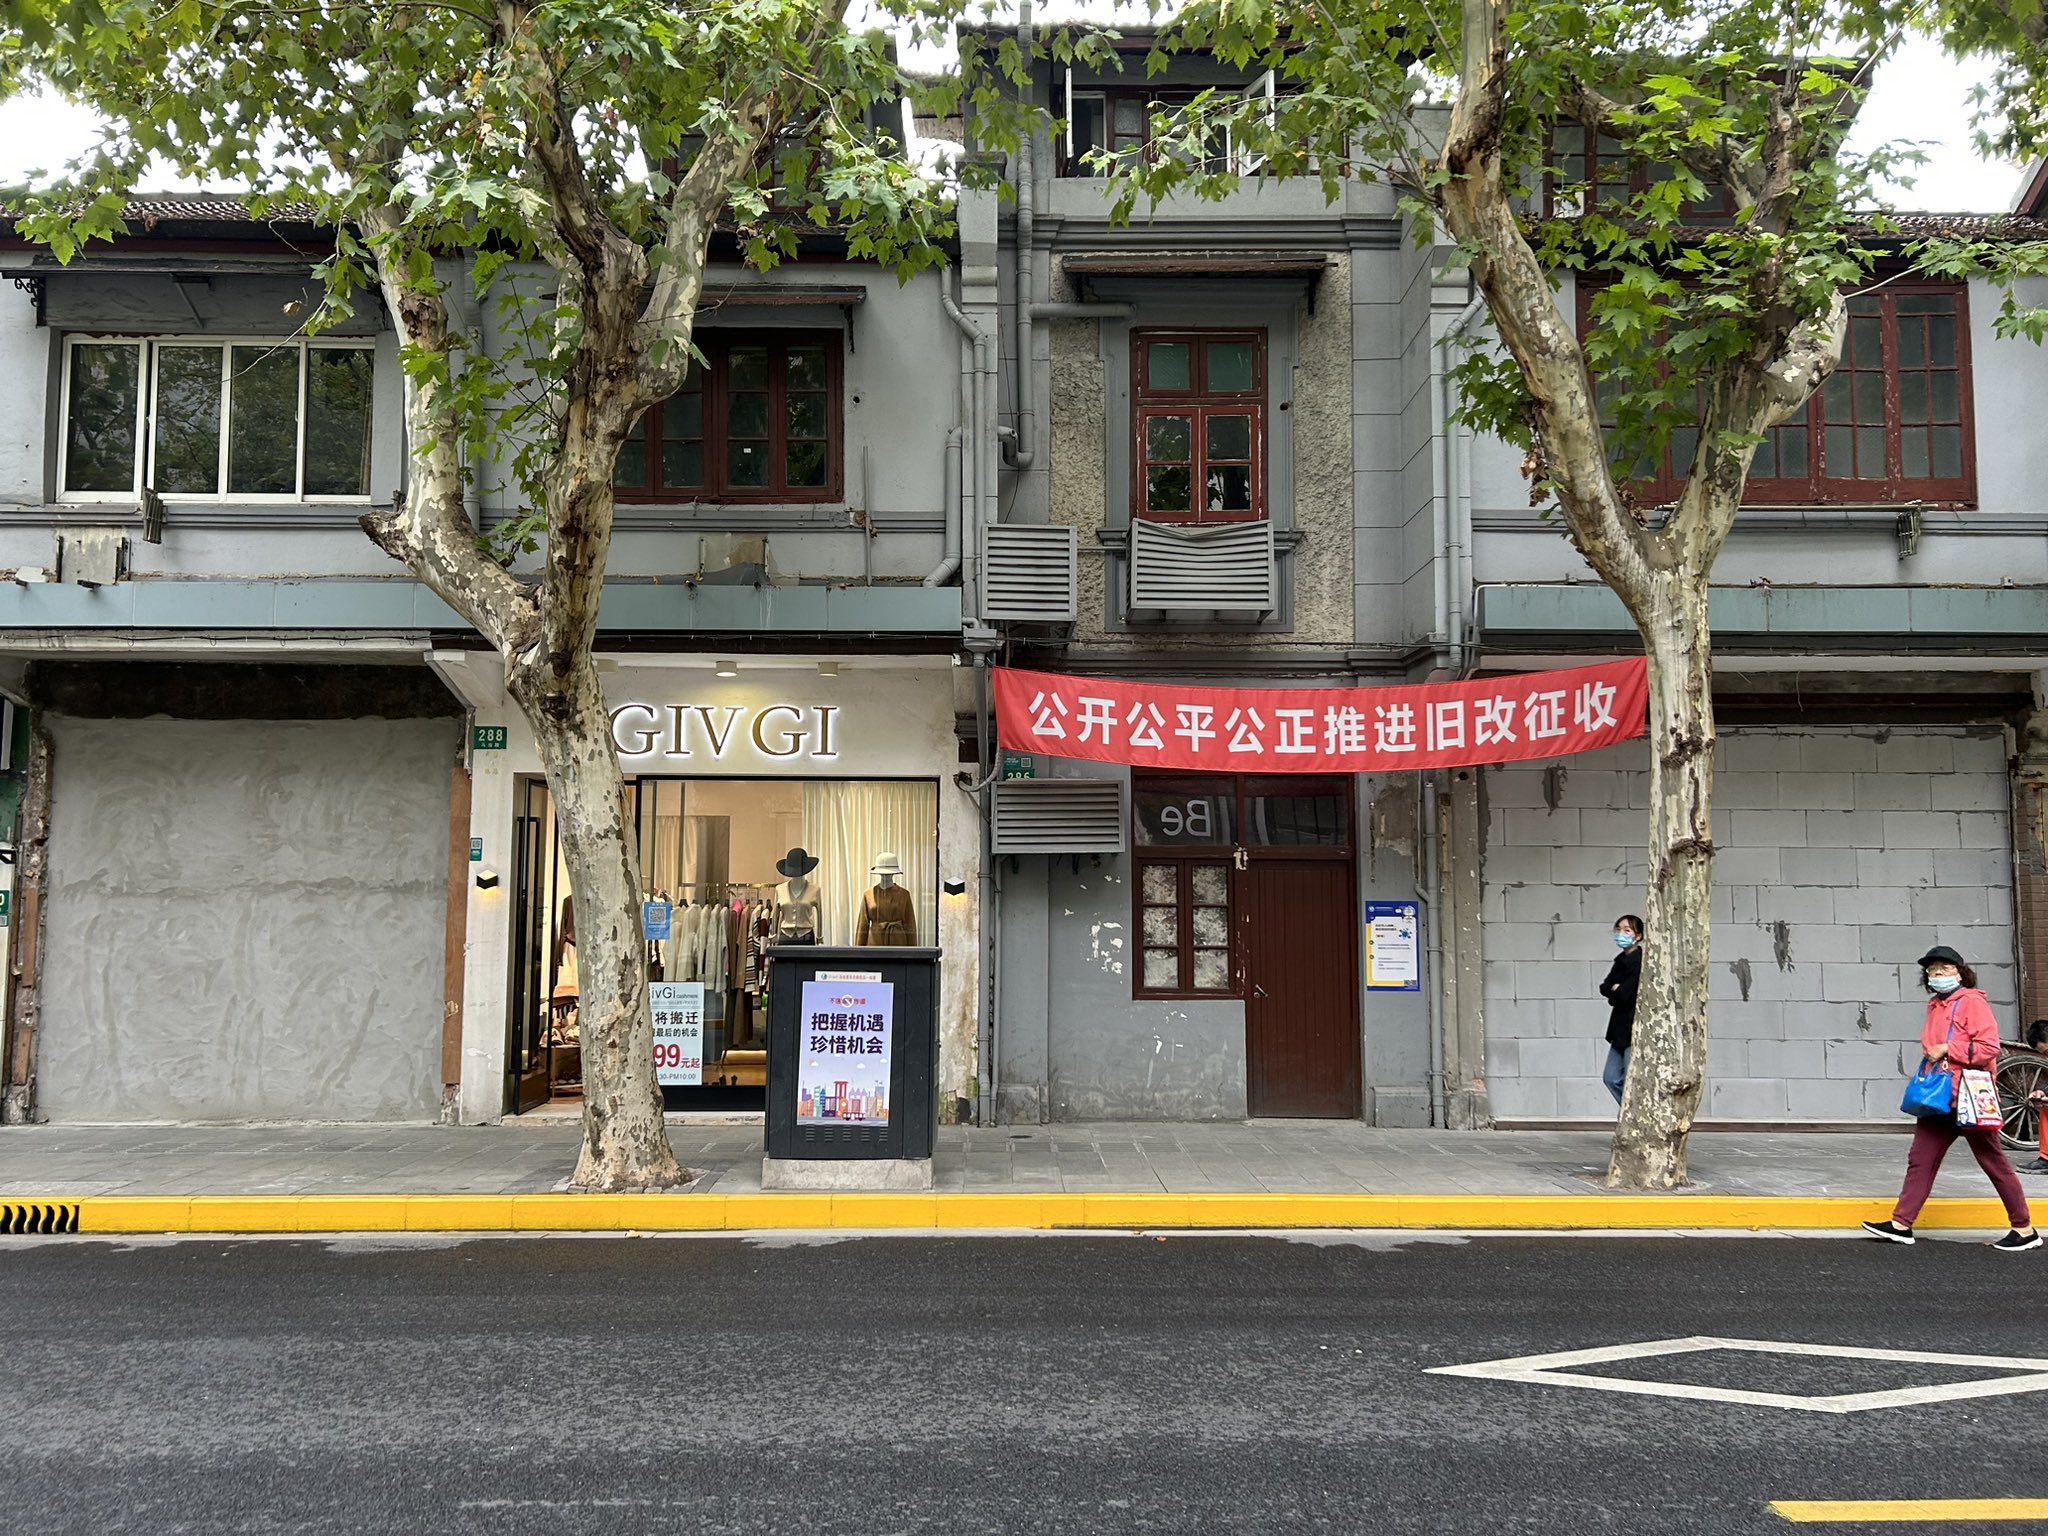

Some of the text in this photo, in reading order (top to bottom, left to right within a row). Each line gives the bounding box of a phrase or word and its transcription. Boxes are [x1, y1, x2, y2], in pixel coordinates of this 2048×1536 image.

[1028, 681, 1618, 755] 公开公平公正推进旧改征收
[478, 729, 503, 741] 288
[608, 703, 839, 757] GIVGI
[651, 986, 676, 999] ivGi
[653, 1011, 699, 1025] 将搬迁
[811, 1012, 884, 1032] 把握机遇
[810, 1035, 883, 1055] 珍惜机会
